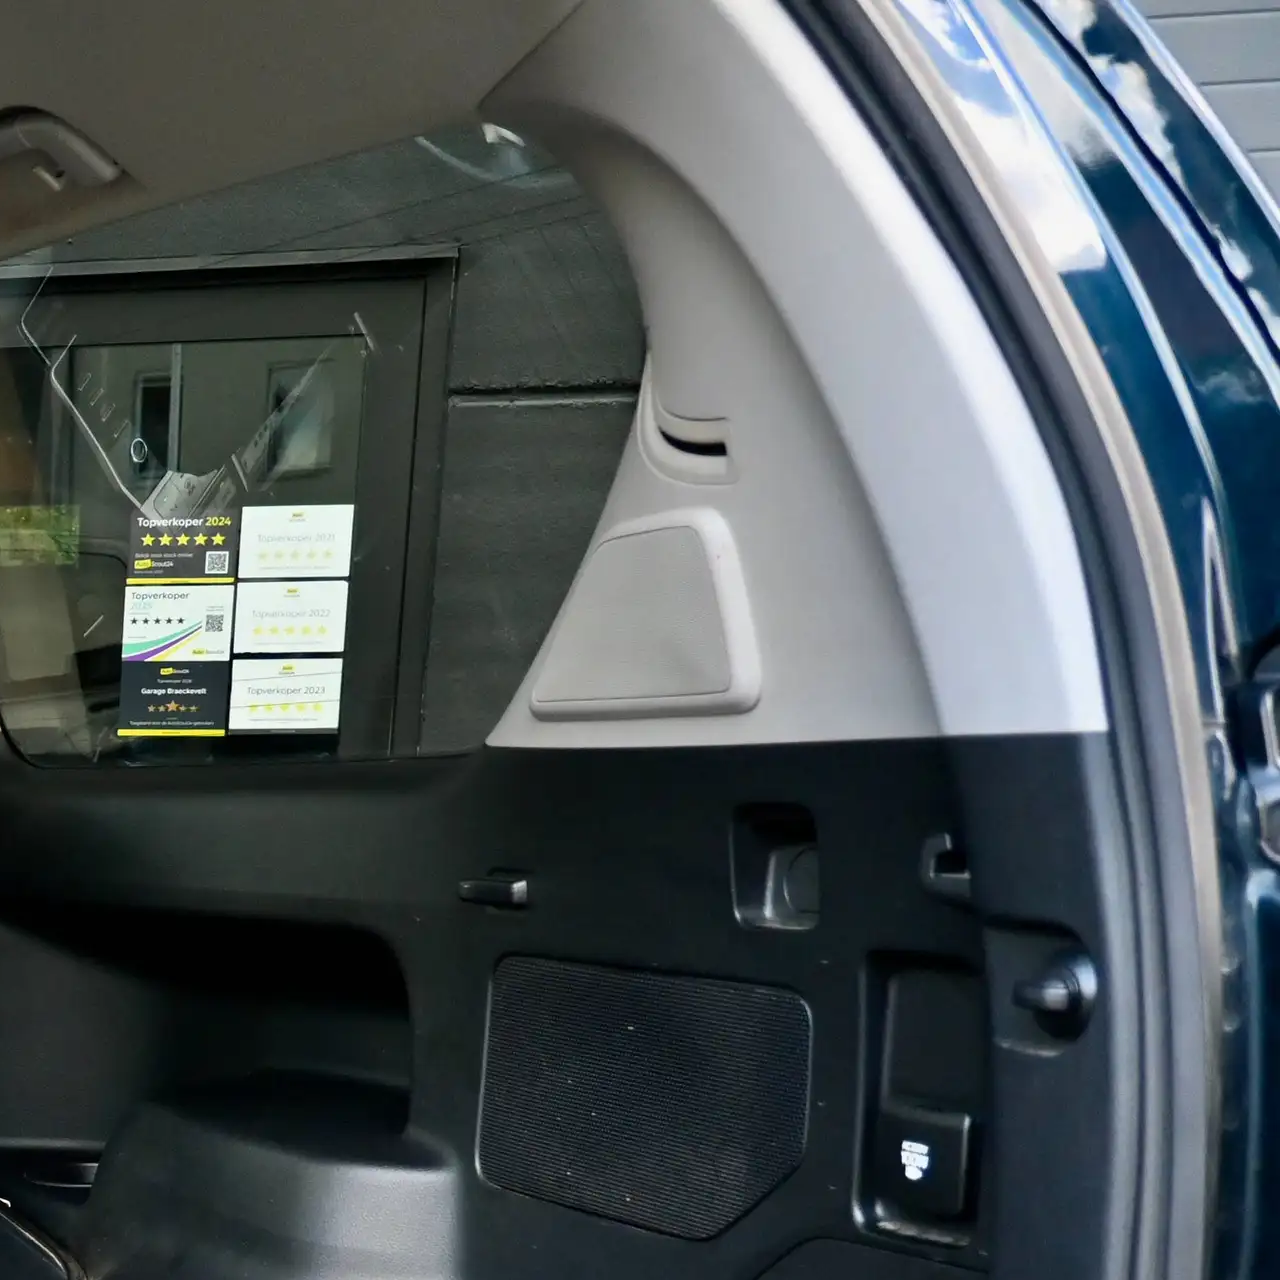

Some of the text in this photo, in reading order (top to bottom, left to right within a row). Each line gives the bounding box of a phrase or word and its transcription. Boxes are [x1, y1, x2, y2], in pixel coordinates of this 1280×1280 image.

[137, 516, 232, 528] Topverkoper 2024
[131, 591, 190, 600] Topverkoper
[308, 608, 331, 617] 2022
[247, 685, 326, 695] Topverkoper 2023
